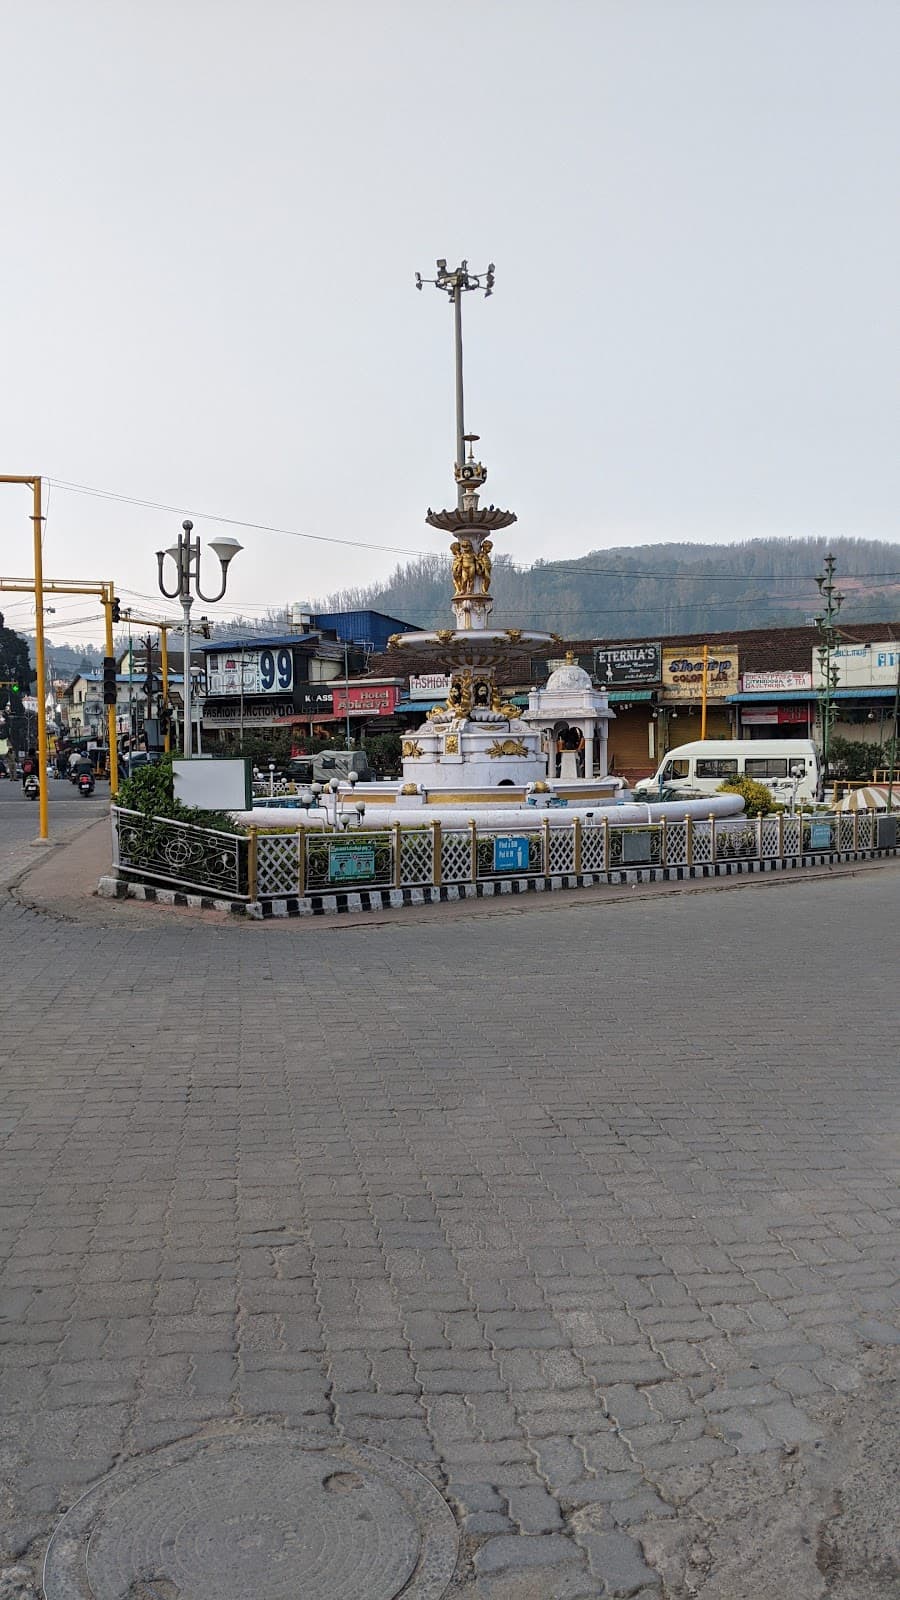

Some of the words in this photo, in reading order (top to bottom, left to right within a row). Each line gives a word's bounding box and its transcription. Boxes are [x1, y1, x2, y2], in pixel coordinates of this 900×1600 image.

[599, 648, 656, 663] ETERNIA'S
[260, 649, 292, 690] 99
[669, 658, 732, 673] Sharp
[411, 677, 449, 689] FASHION
[361, 690, 389, 699] Hotel
[203, 706, 236, 718] FASHION
[238, 705, 276, 717] JUNCTION
